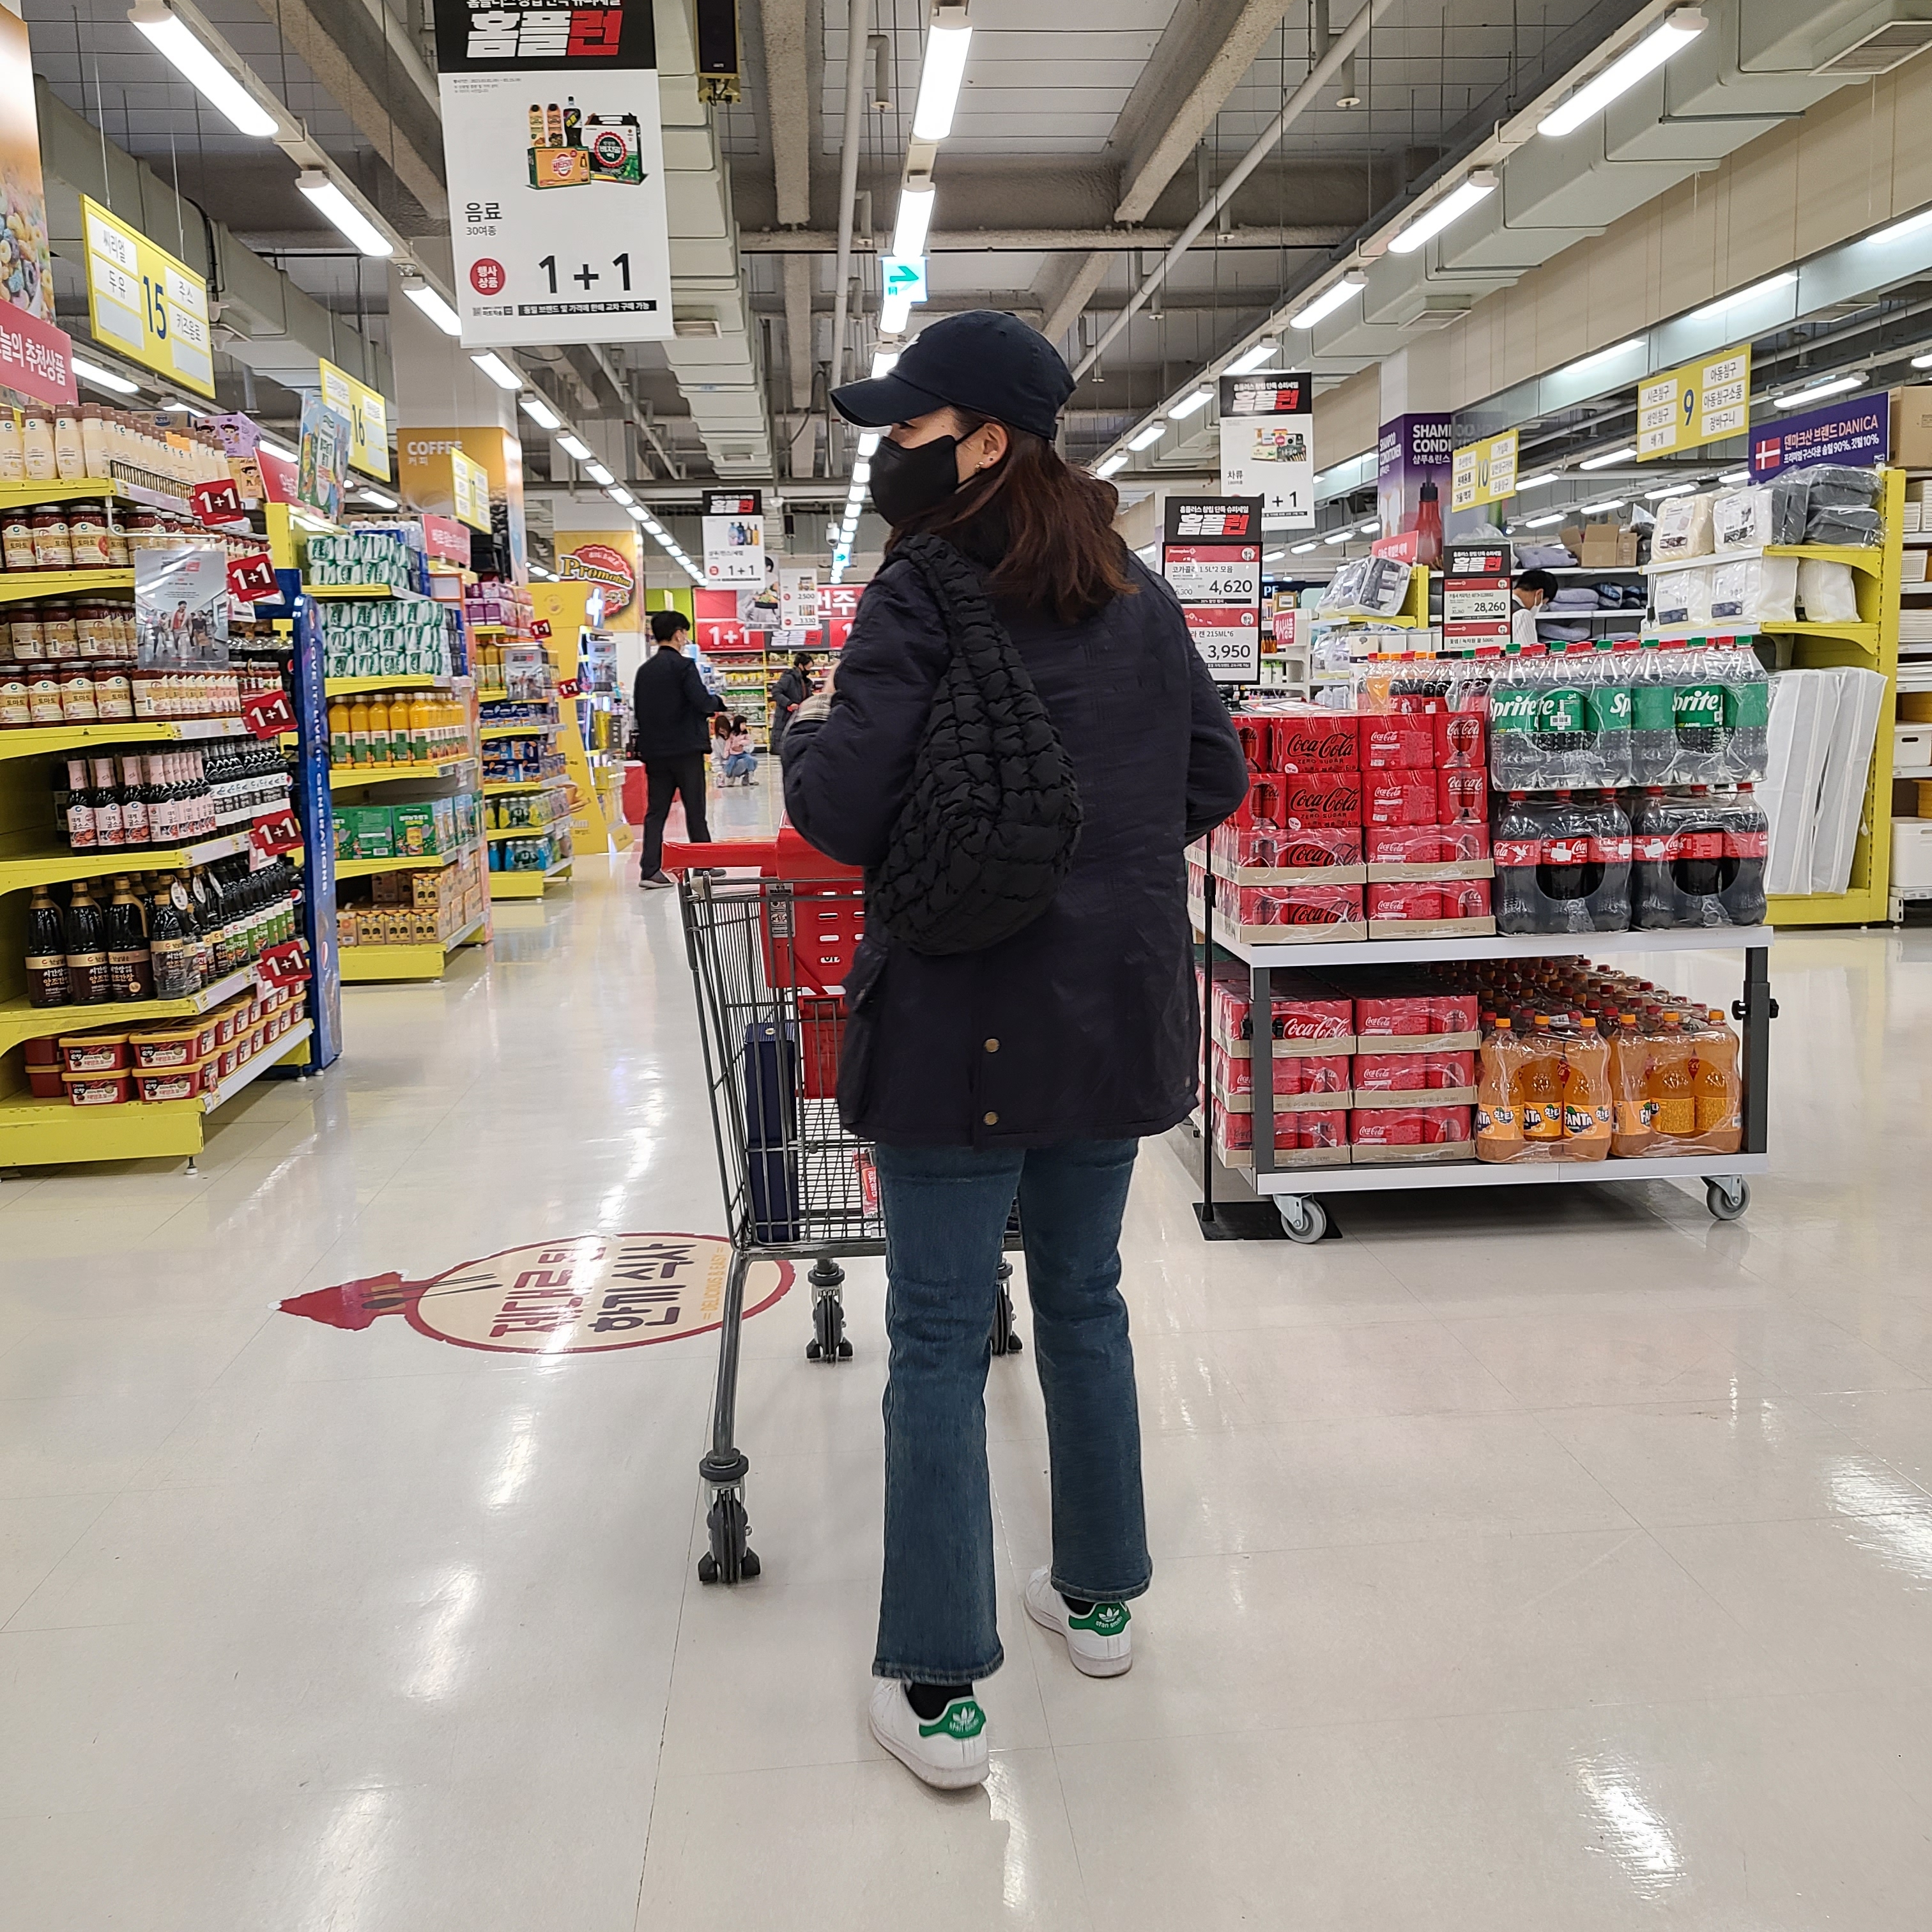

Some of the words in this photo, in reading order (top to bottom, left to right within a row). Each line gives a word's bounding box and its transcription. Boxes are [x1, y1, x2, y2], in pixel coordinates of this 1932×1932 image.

[466, 10, 623, 58] 홈플런
[465, 203, 502, 223] 음료
[466, 226, 497, 236] 30여종
[477, 265, 498, 277] 행사
[109, 270, 126, 299] 두유
[143, 275, 166, 339] 15
[26, 338, 66, 386] 추천상품
[1710, 362, 1736, 382] 아동침구
[1232, 390, 1300, 412] 홈플런
[1684, 389, 1694, 426] 9
[1703, 385, 1742, 408] 아동침구소품
[352, 404, 365, 446] 16
[1710, 410, 1735, 431] 장바구니
[1784, 430, 1813, 450] 덴마크산
[1814, 423, 1837, 442] 브랜드
[1839, 414, 1878, 436] DANICA
[1864, 433, 1879, 446] 10%
[1478, 459, 1488, 487] 10
[199, 488, 237, 513] 1+1
[1177, 514, 1249, 535] 홈플런
[232, 562, 272, 590] 1+1
[1209, 579, 1252, 595] 4,620
[1474, 602, 1506, 613] 28,260
[1208, 645, 1250, 661] 3,950
[250, 699, 289, 727] 1+1
[258, 818, 296, 845] 1+1
[266, 949, 303, 976] 1+1
[1494, 1108, 1514, 1120] 환타
[1564, 1112, 1593, 1126] FANTA
[611, 1243, 697, 1280] 식사
[586, 1284, 687, 1333] 한끼
